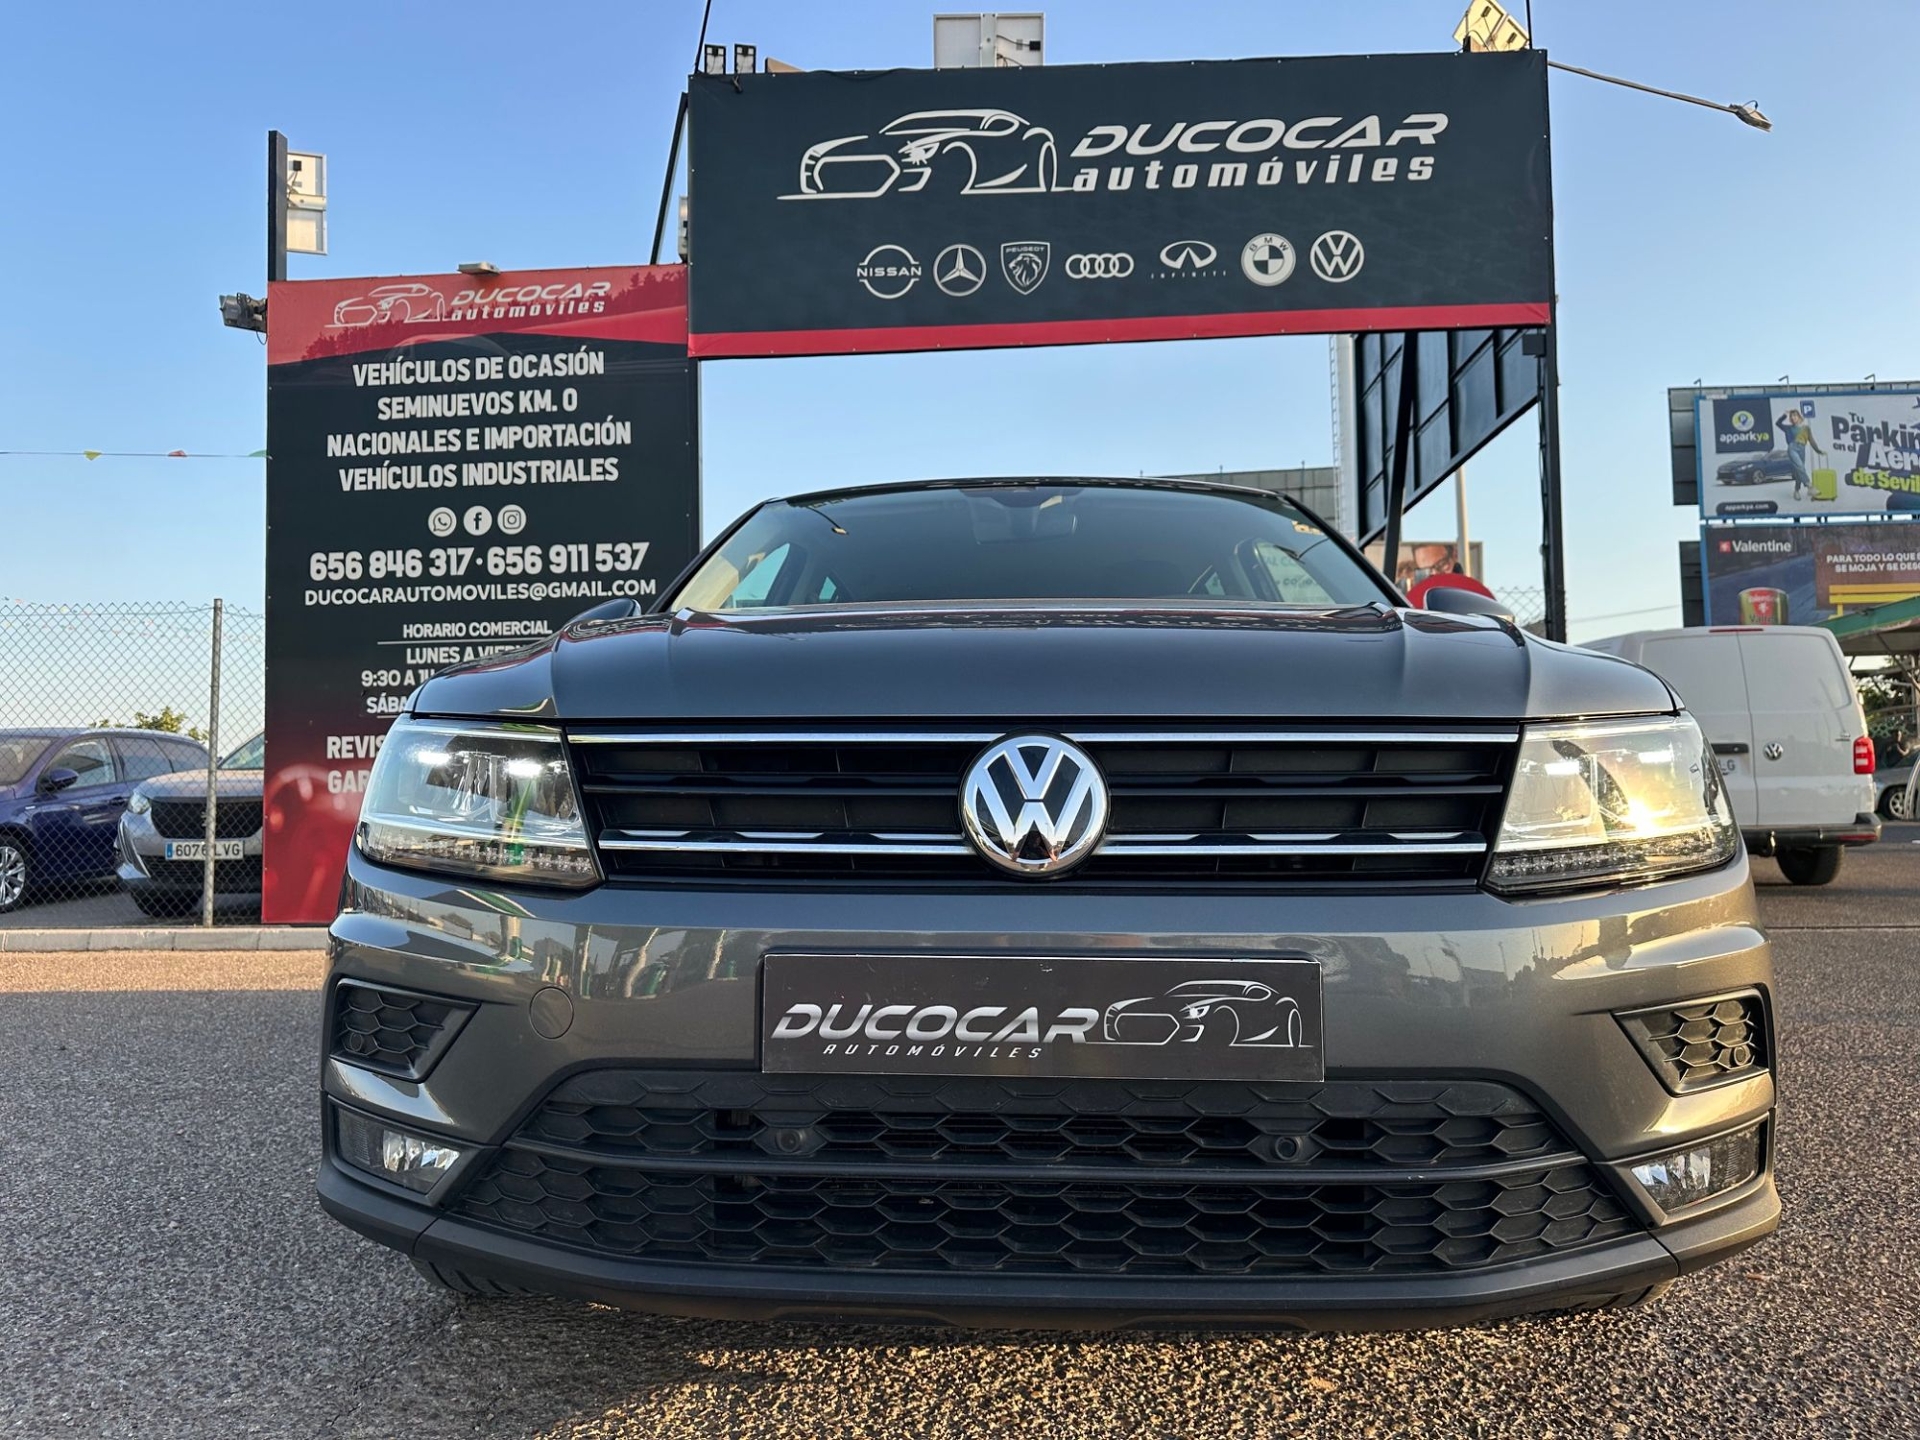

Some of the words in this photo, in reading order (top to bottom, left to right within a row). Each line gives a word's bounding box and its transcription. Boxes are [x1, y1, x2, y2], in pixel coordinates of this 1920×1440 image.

[1070, 113, 1449, 157] DUCOCAR
[1073, 154, 1435, 191] automóviles
[1249, 236, 1289, 252] BMW
[857, 266, 922, 277] NISSAN
[450, 281, 611, 306] DUCOCAR
[352, 355, 470, 387] VEHÍCULOS
[475, 356, 503, 380] DE
[508, 346, 604, 378] OCASIÓN
[377, 391, 514, 421] SEMINUEVOS
[519, 389, 557, 413] KM.
[1848, 412, 1865, 424] Tu
[326, 428, 461, 457] NACIONALES
[466, 428, 480, 450] E
[484, 415, 631, 450] IMPORTACIÓN
[1719, 431, 1770, 444] apparkya
[1832, 442, 1846, 452] en
[338, 460, 457, 491] VEHÍCULOS
[462, 457, 619, 486] INDUSTRIALES
[1852, 467, 1875, 486] de
[1732, 540, 1791, 553] Valentine
[309, 552, 363, 581] 656
[369, 549, 422, 578] 846
[549, 543, 589, 573] 911
[595, 542, 650, 572] 537
[1826, 554, 1853, 564] PARA
[1854, 553, 1881, 563] TODO
[1882, 553, 1895, 562] LO
[1895, 552, 1915, 562] QUE
[1835, 564, 1847, 573] SE
[1848, 563, 1877, 572] MOJA
[1878, 563, 1886, 571] Y
[1886, 562, 1899, 571] SE
[304, 579, 656, 606] DUCOCARAUTOMOVILES@GMAIL.COM
[403, 622, 466, 639] HORARIO
[469, 620, 553, 637] COMERCIAL
[406, 647, 460, 664] LUNES
[463, 646, 475, 663] A
[361, 670, 401, 687] 9:30
[403, 669, 416, 687] A
[214, 843, 240, 857] LVG
[771, 1003, 1100, 1043] DUCOCAR
[823, 1044, 1042, 1059] AUTOMÓVILES
